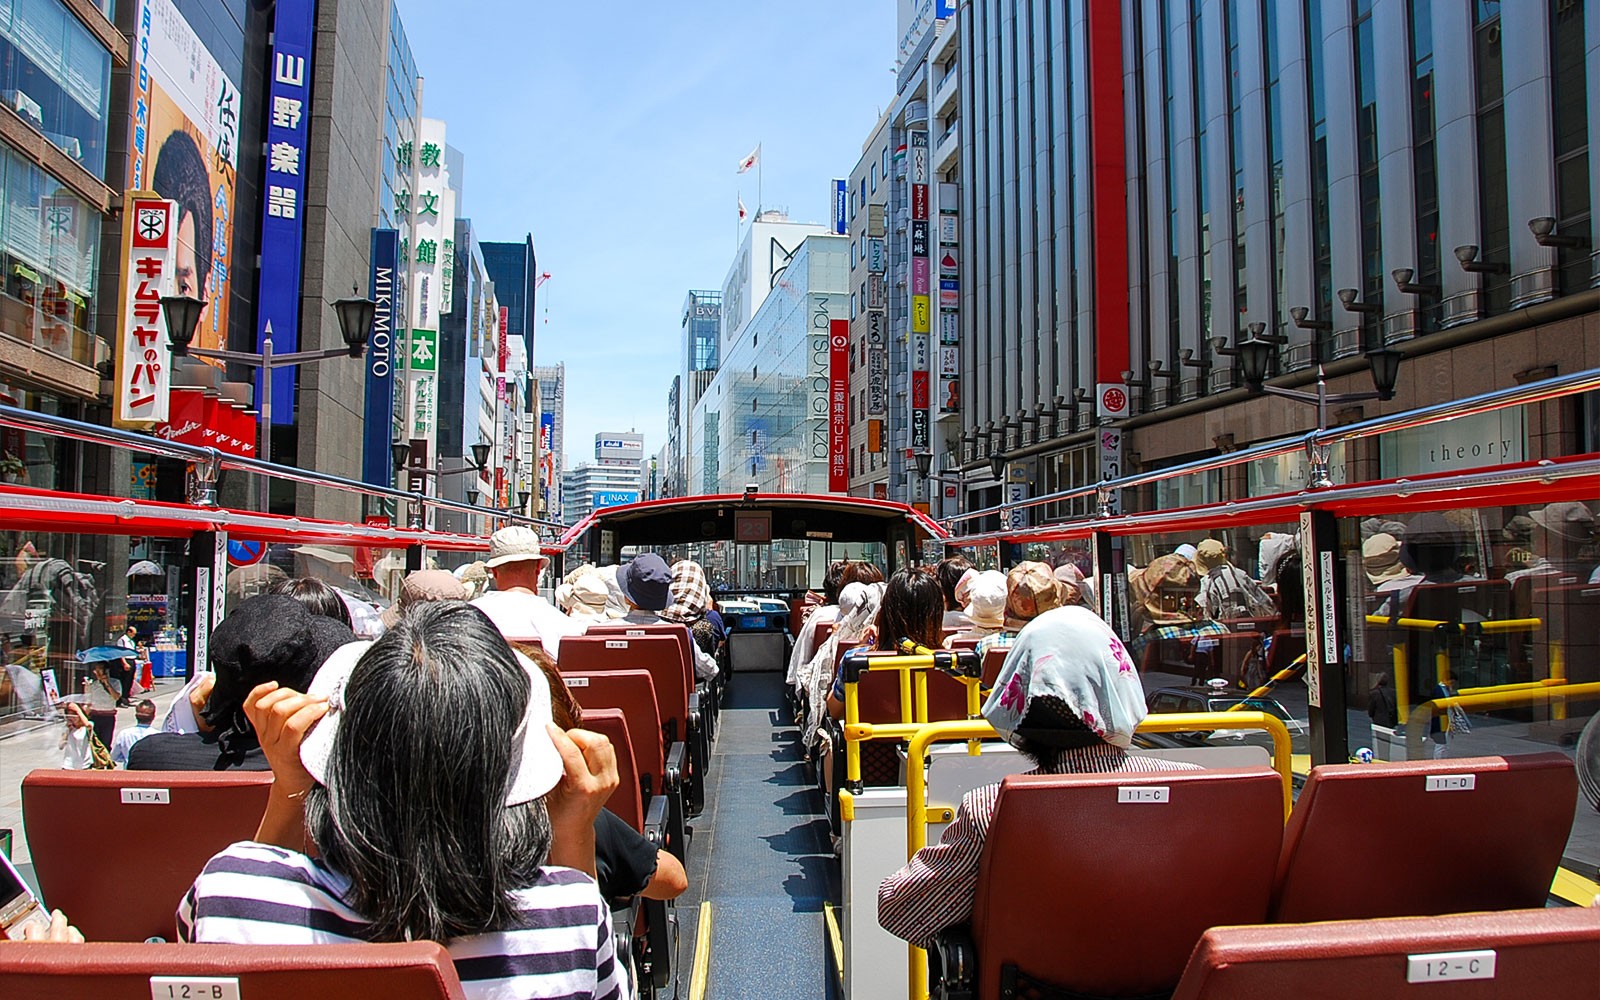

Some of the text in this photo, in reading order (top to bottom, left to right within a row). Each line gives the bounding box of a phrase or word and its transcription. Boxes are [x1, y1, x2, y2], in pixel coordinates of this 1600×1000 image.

[268, 53, 304, 219] 山野楽器
[416, 141, 441, 264] 教文館
[130, 257, 163, 408] キムラヤのパン
[372, 267, 392, 377] MIKIMOTO
[870, 312, 882, 343] ざくろ
[412, 336, 434, 364] 本
[415, 378, 427, 433] ナルニア国
[159, 420, 201, 440] Fender
[833, 380, 845, 477] 三菱東京UFJ銀行
[1430, 439, 1512, 463] theory
[1289, 465, 1347, 481] thry
[608, 493, 629, 502] INAX
[743, 523, 765, 536] 23
[1301, 517, 1319, 702] シートベルトをおしめ下さい
[1127, 789, 1162, 801] 11-C
[1435, 777, 1468, 789] 11-D
[129, 792, 161, 802] 11-A
[1424, 958, 1482, 977] 12-C
[168, 984, 223, 999] 12-B
